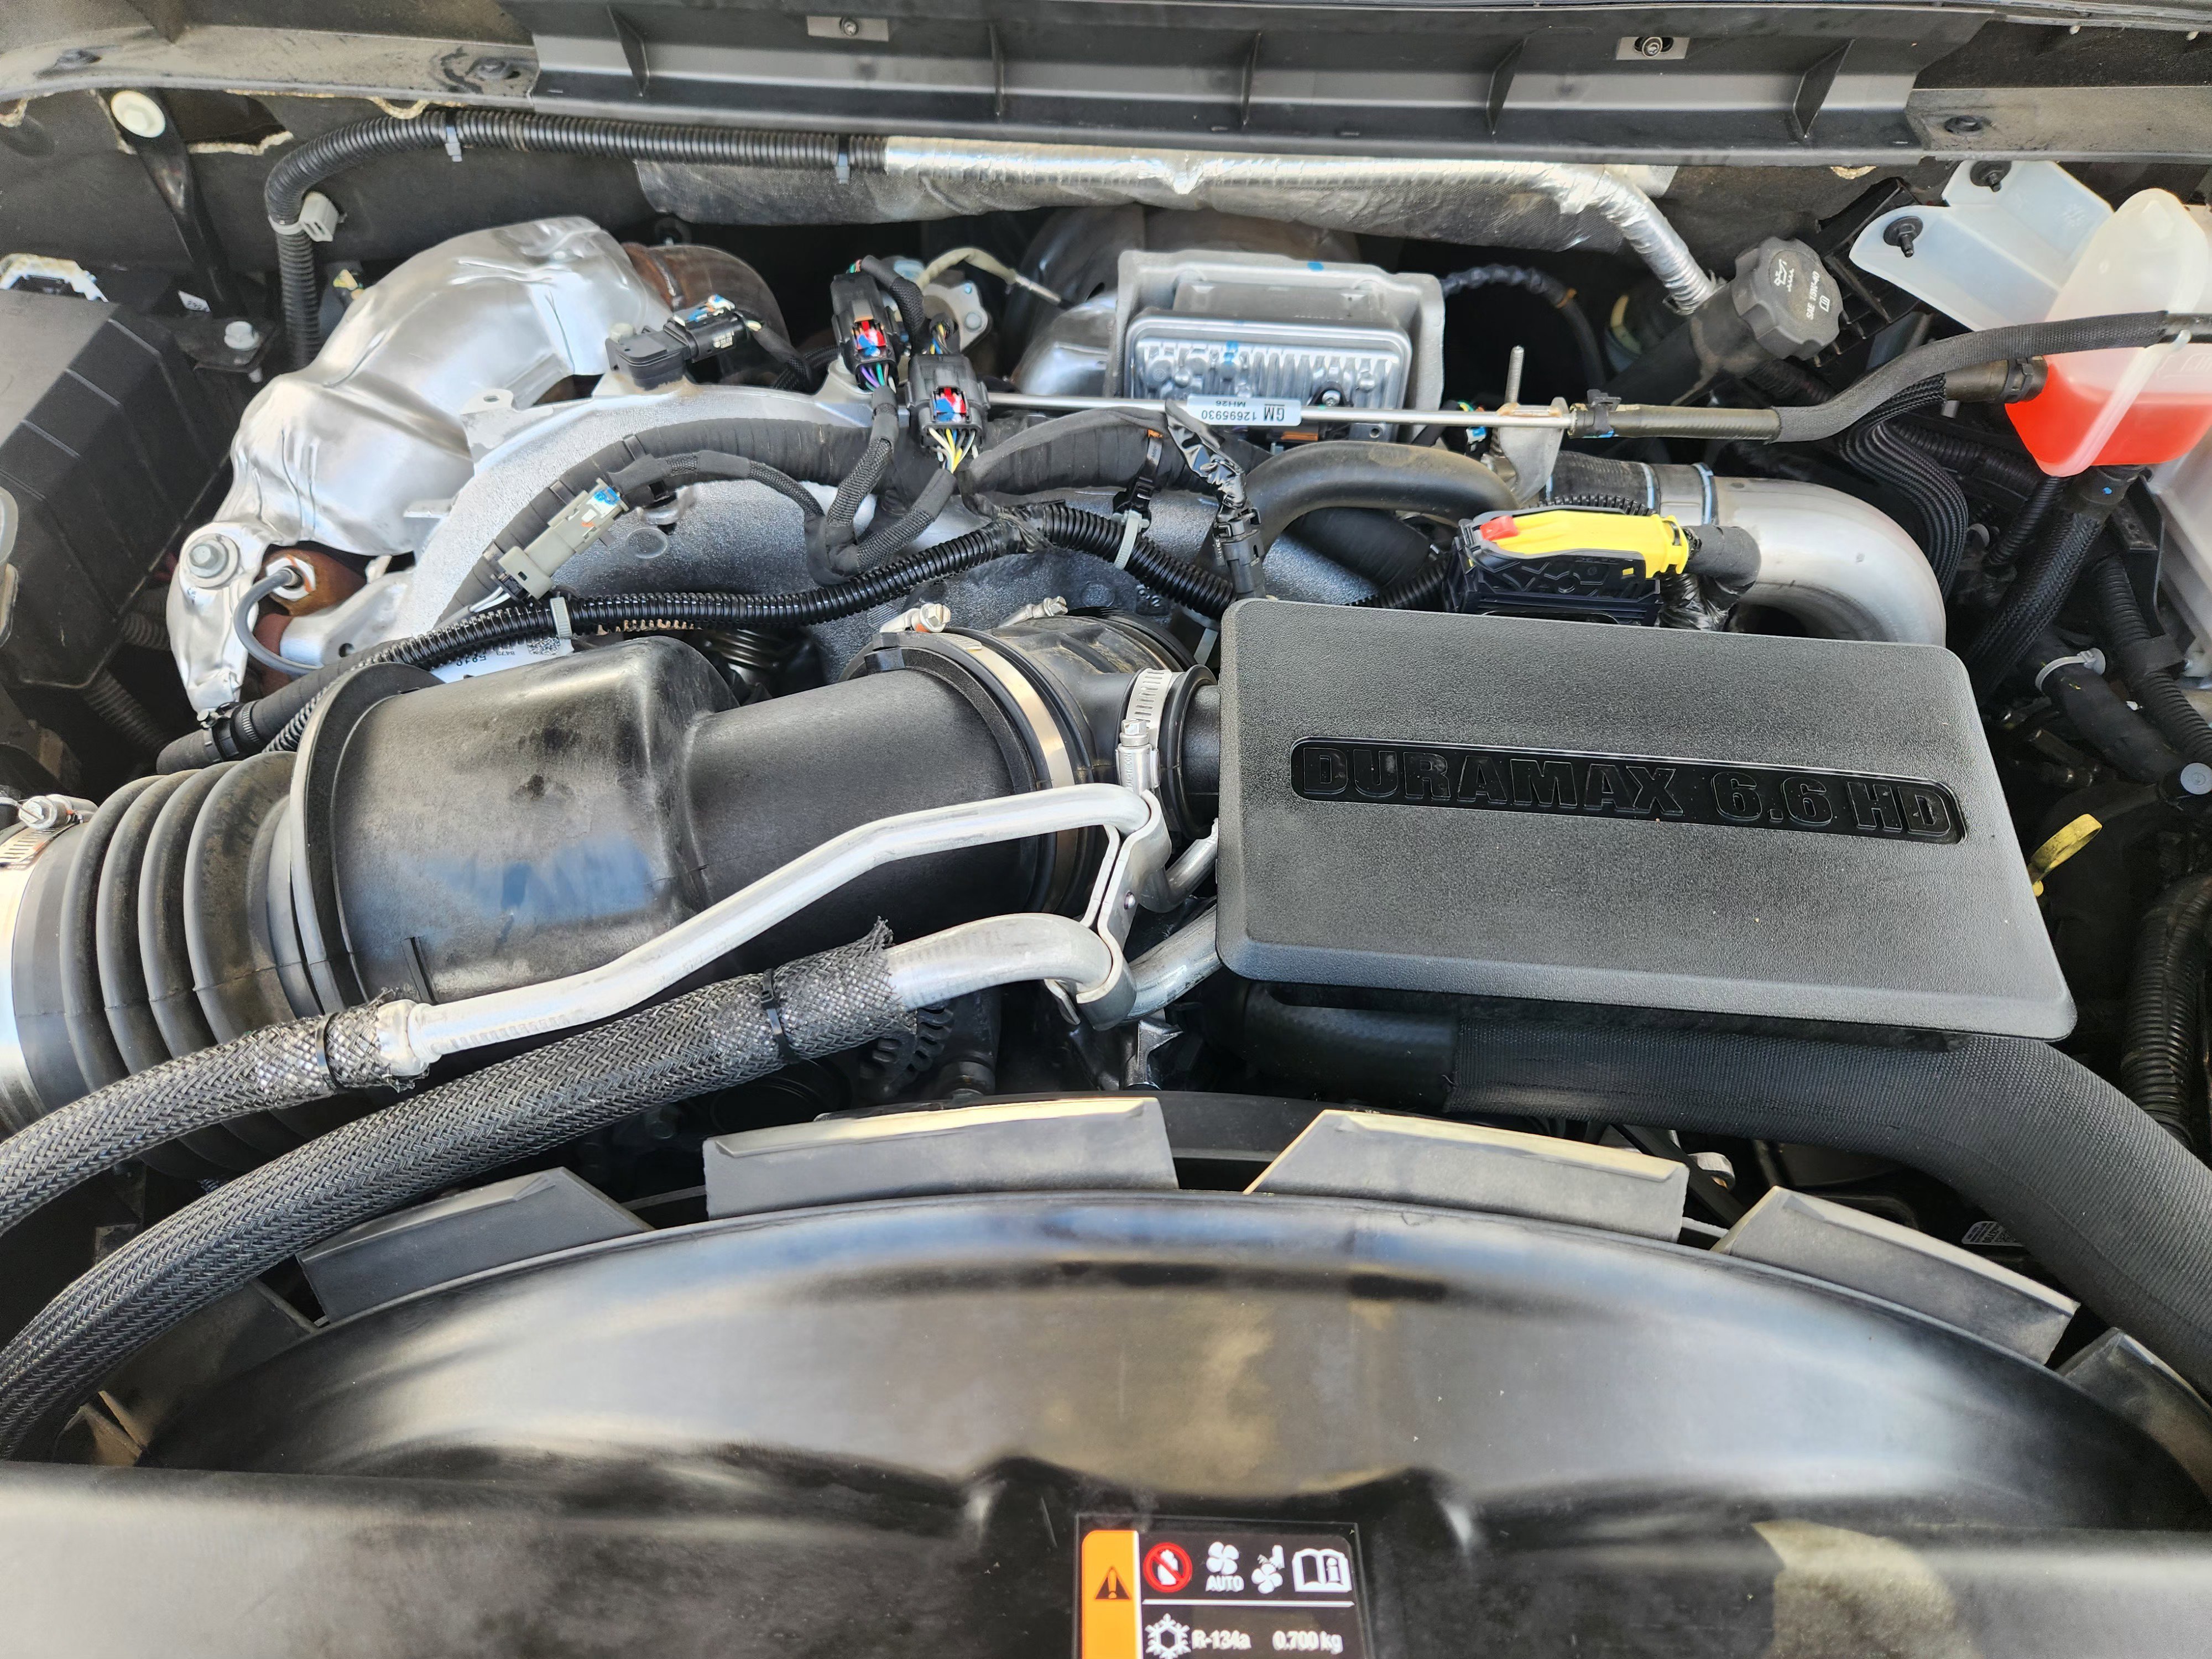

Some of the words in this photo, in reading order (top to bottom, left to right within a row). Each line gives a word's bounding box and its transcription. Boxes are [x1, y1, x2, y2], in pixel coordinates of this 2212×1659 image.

[1809, 270, 1820, 301] 15W-40
[1806, 302, 1815, 320] SAE
[1201, 410, 1256, 421] 12695930
[1263, 406, 1285, 421] GM
[1303, 747, 1683, 815] DURAMAX
[1711, 771, 1833, 826] 6.6
[1845, 780, 1951, 837] HD
[1205, 1575, 1244, 1593] AUTO
[1191, 1629, 1251, 1650] R-134a
[1272, 1630, 1319, 1651] 0.700
[1320, 1631, 1344, 1655] kg
